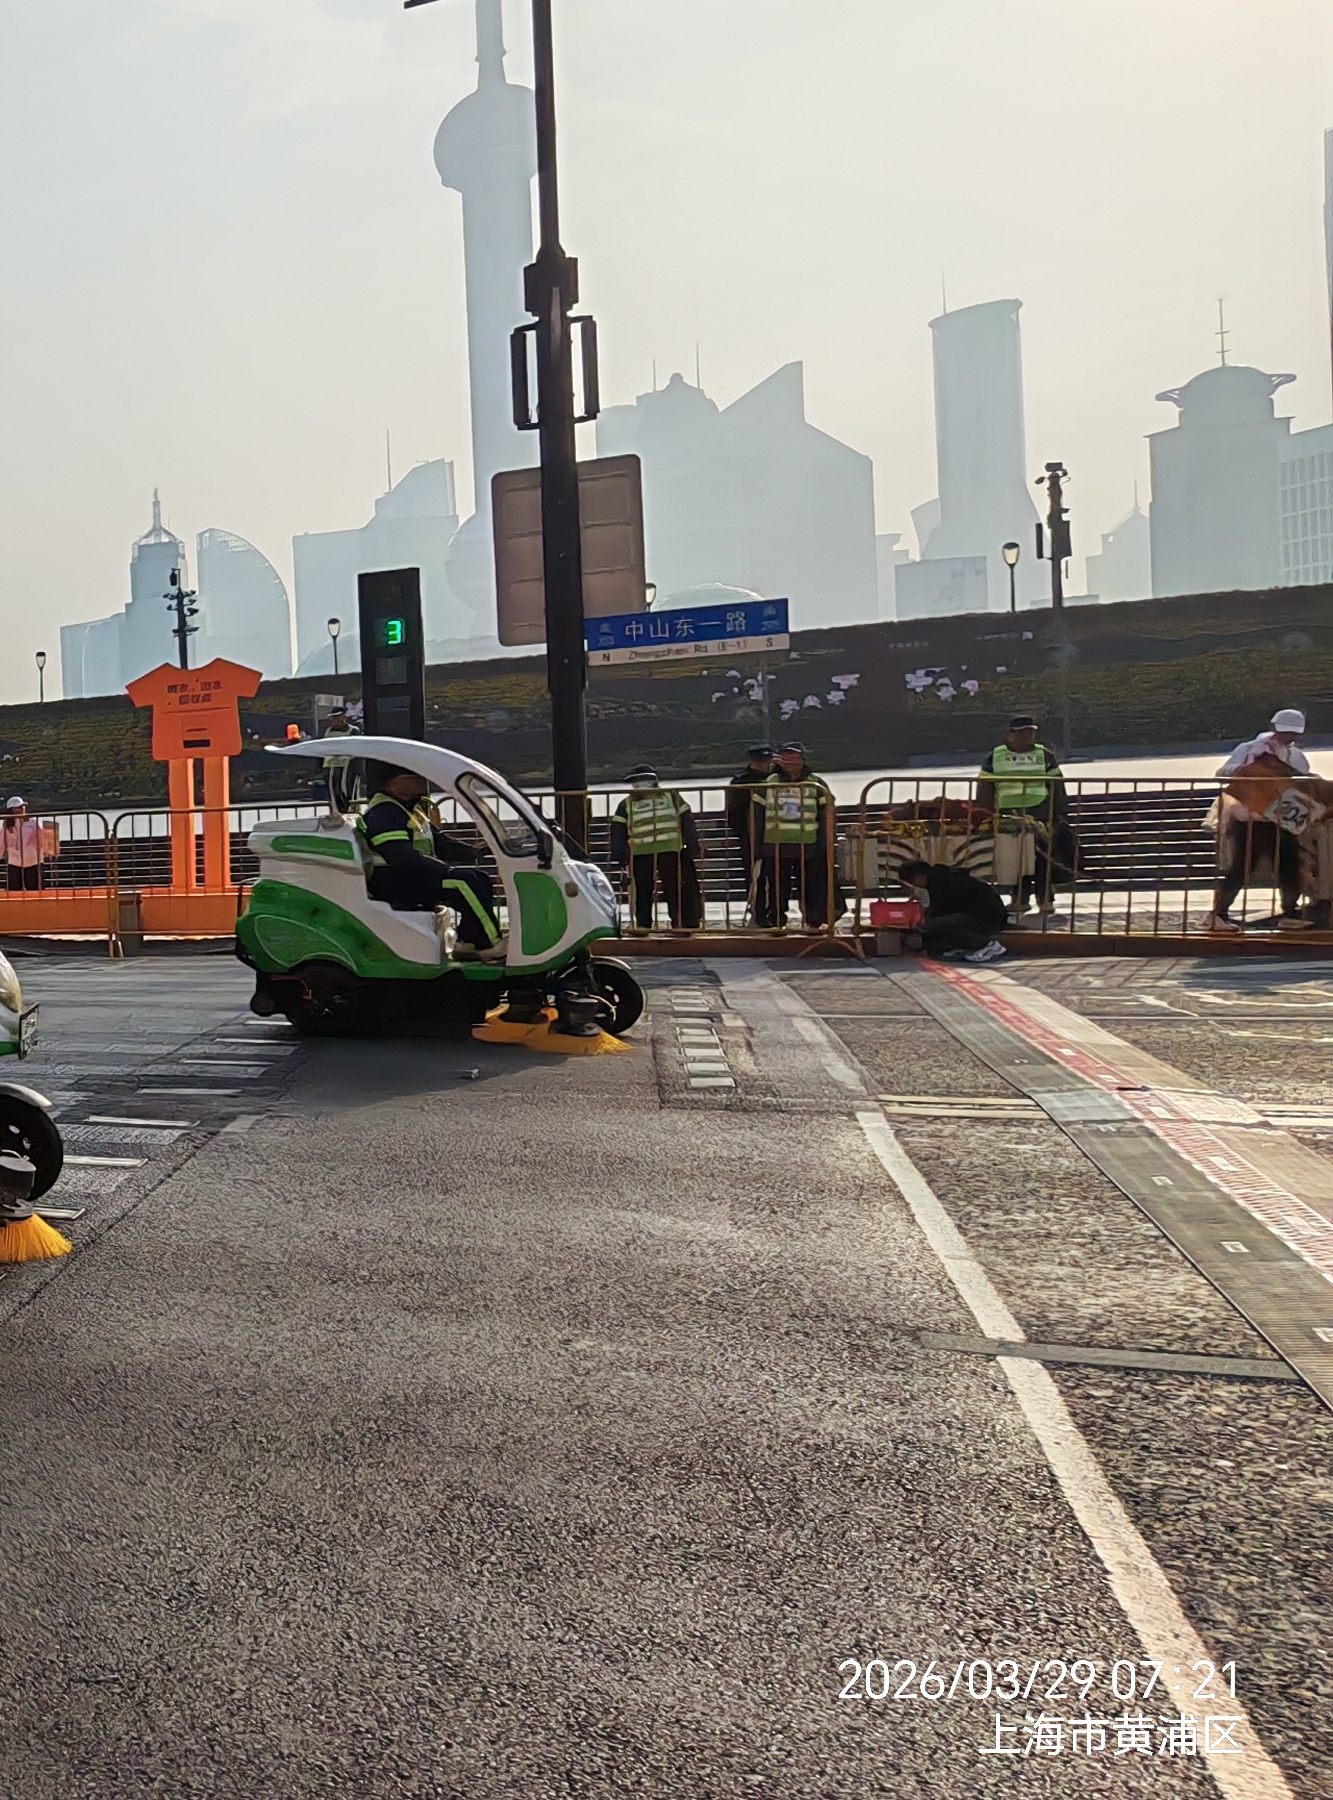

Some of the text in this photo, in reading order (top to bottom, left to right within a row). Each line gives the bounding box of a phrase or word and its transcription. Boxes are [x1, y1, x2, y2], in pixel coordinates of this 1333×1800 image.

[387, 620, 402, 645] 3
[625, 611, 746, 642] 中山东一路
[602, 653, 611, 662] N
[694, 643, 708, 653] Rd
[765, 637, 774, 648] S
